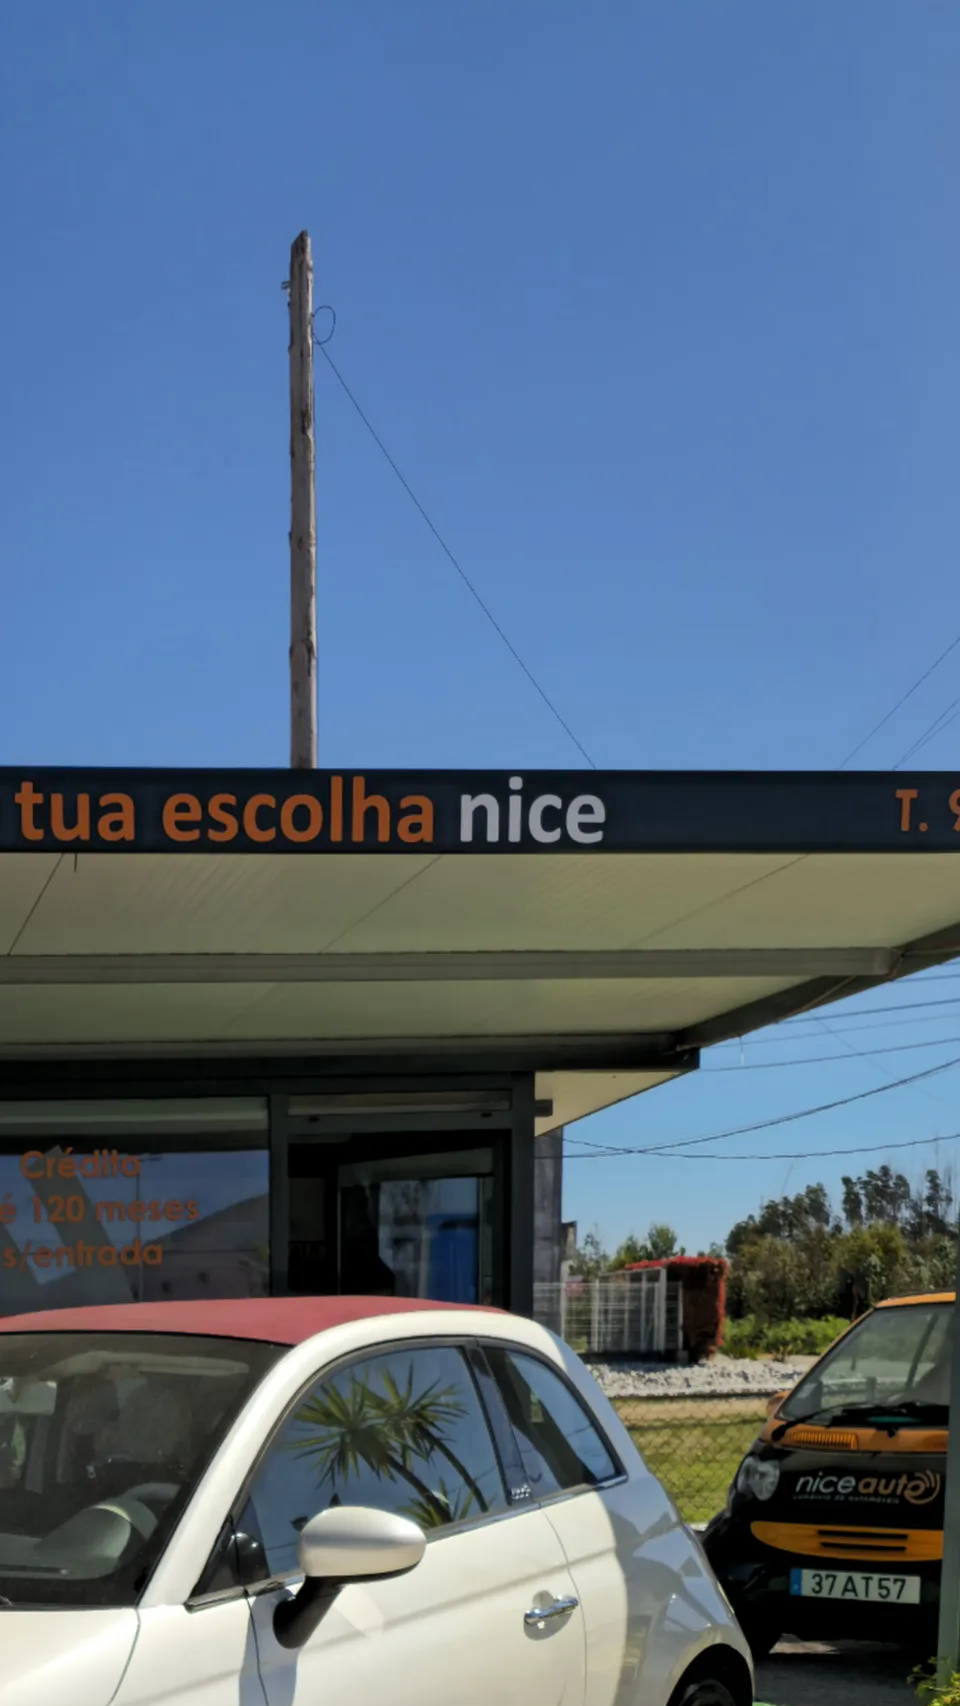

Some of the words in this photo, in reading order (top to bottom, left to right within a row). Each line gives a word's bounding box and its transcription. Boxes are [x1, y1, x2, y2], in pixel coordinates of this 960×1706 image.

[14, 781, 136, 842] tua
[161, 775, 435, 844] escolha
[459, 776, 607, 845] nice
[895, 788, 929, 832] T.
[20, 1147, 141, 1180] Crédito
[31, 1194, 86, 1224] 120
[96, 1196, 200, 1222] meses
[2, 1239, 164, 1271] s/entrada
